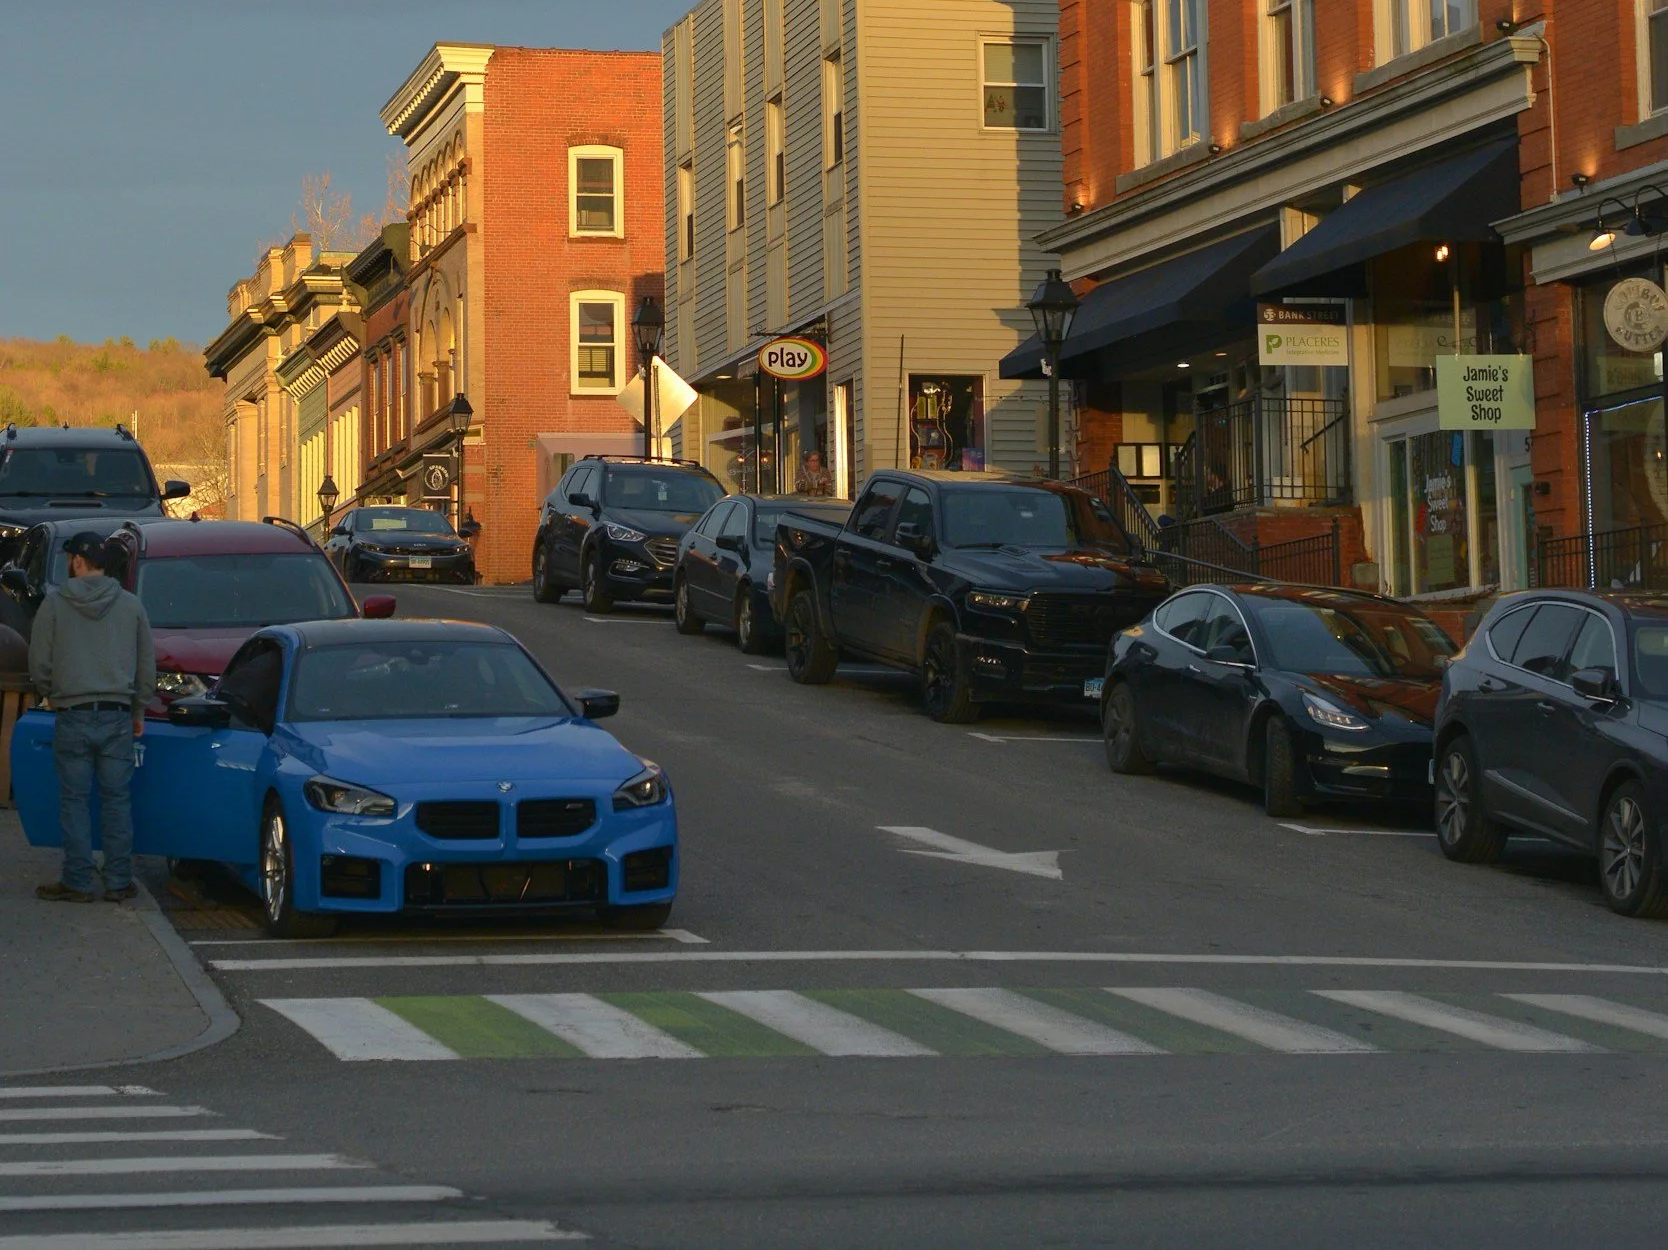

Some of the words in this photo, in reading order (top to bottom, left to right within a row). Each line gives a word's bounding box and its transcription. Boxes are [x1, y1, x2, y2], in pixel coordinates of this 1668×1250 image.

[1278, 310, 1305, 320] BANK
[1307, 310, 1339, 320] STREET
[1286, 337, 1340, 347] PLACERES
[768, 347, 808, 368] play
[1463, 365, 1509, 382] Jamie's
[1466, 385, 1504, 402] Sweet
[1471, 404, 1502, 424] Shop
[1424, 470, 1452, 493] Jamie's
[1427, 493, 1449, 512] Sweet
[1430, 514, 1447, 533] Shop
